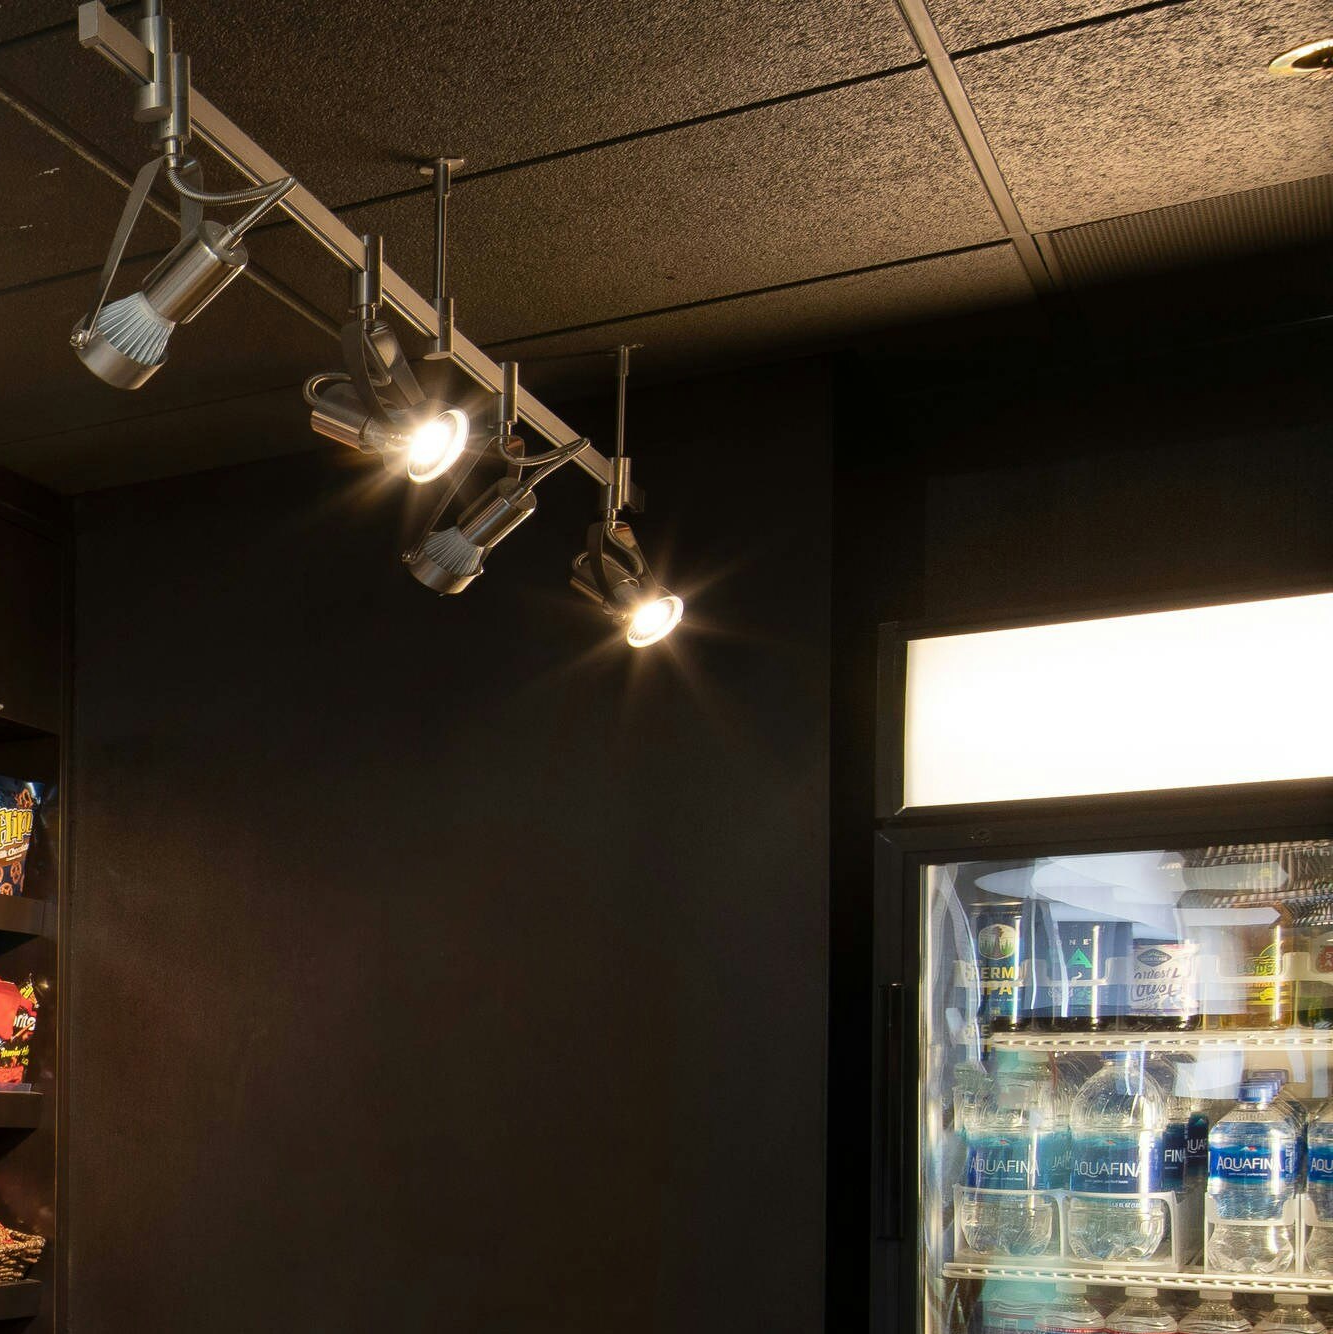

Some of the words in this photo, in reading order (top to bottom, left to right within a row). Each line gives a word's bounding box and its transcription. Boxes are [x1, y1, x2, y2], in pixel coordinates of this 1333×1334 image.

[969, 1158, 1041, 1177] AQUAFINA
[1074, 1161, 1142, 1179] AQUAFINA
[1216, 1157, 1285, 1173] AQUAFINA
[1310, 1157, 1333, 1174] AQU
